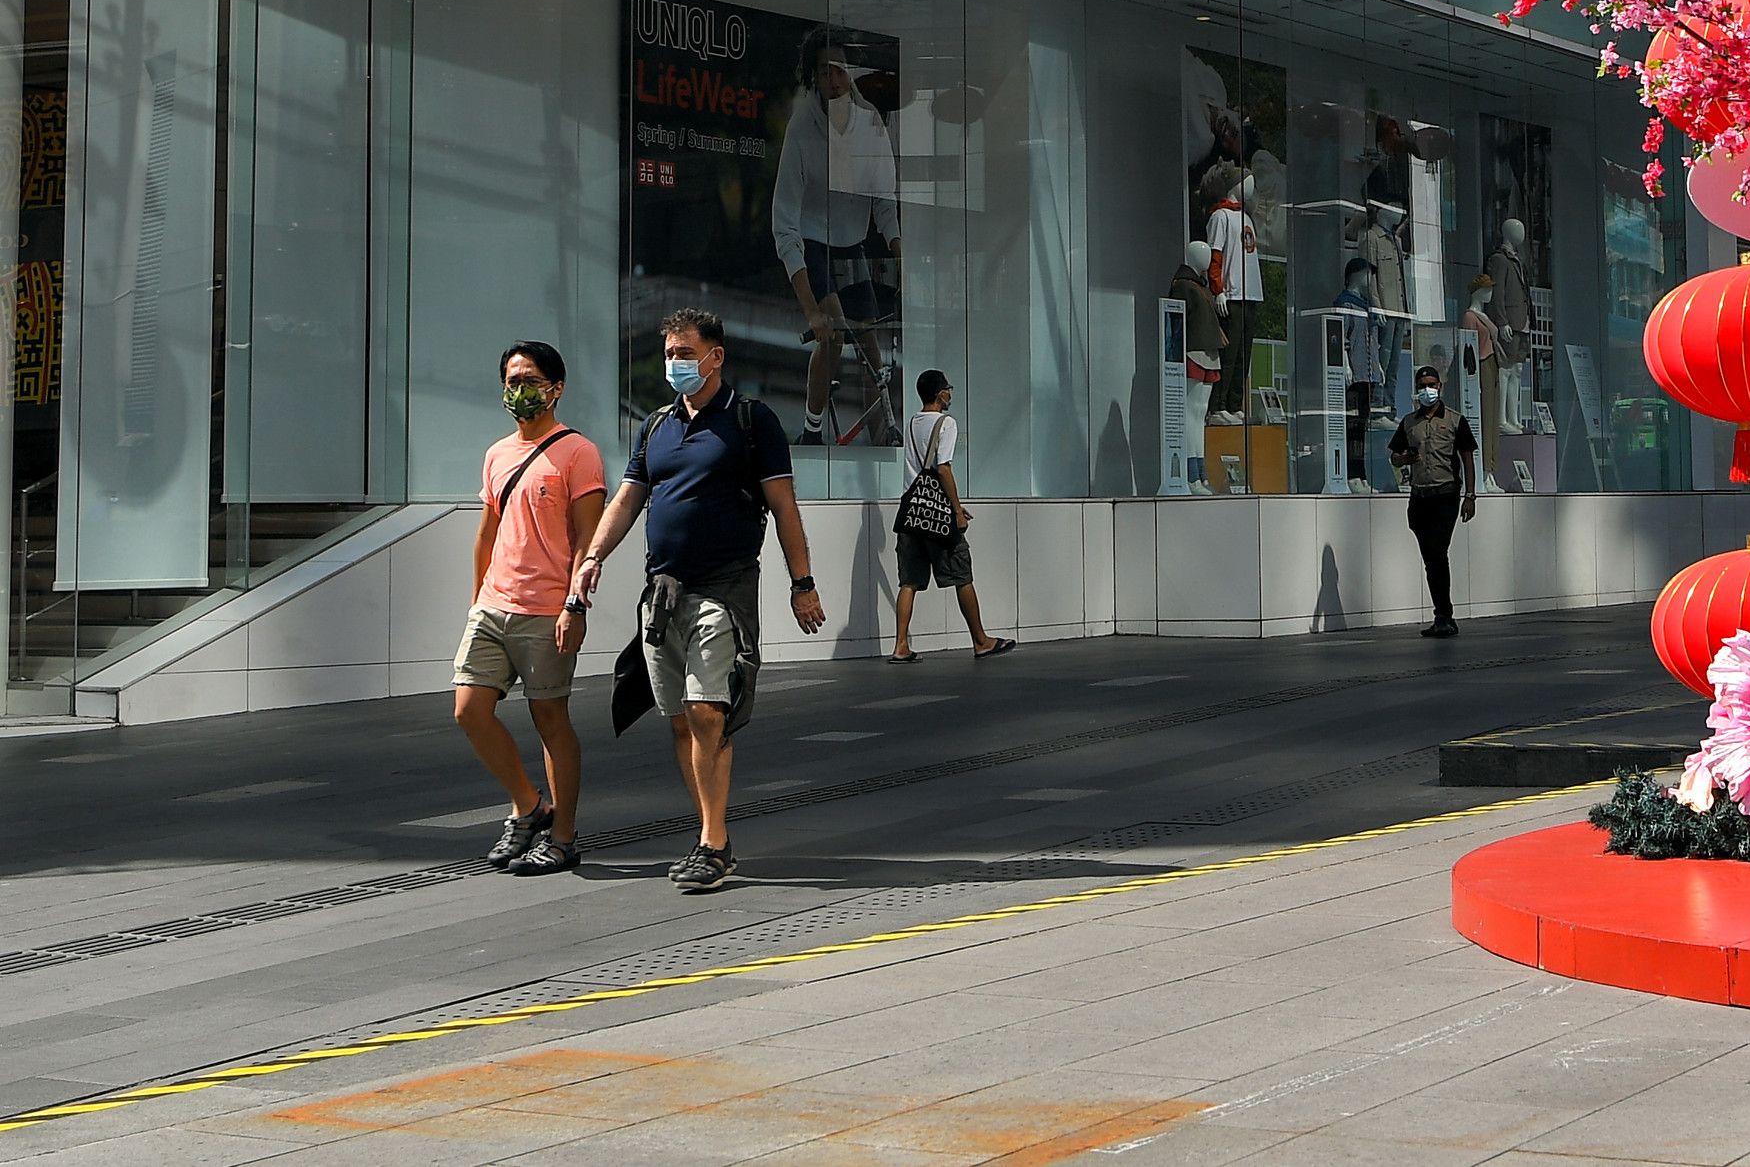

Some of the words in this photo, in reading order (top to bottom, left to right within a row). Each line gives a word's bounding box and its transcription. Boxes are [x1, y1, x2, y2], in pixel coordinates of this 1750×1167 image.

[637, 59, 765, 120] LifeWear
[637, 121, 676, 150] Spring
[687, 128, 737, 154] Summer
[739, 136, 766, 159] 2021
[907, 505, 952, 524] APOLLO
[909, 496, 952, 515] APOLLO
[903, 515, 950, 536] APOLLO
